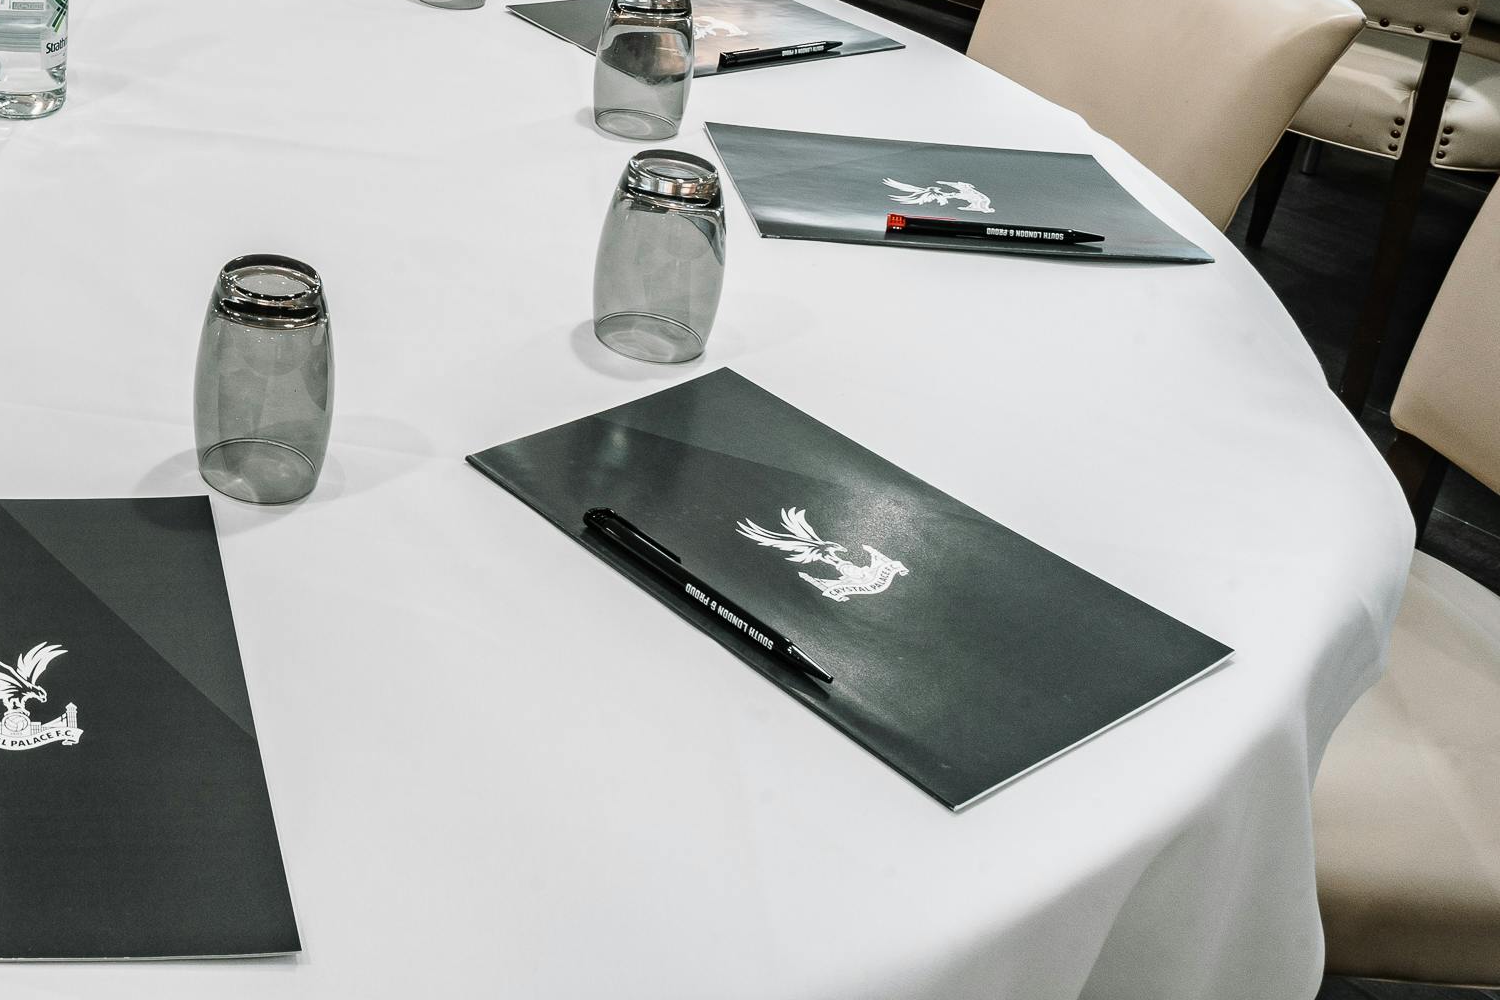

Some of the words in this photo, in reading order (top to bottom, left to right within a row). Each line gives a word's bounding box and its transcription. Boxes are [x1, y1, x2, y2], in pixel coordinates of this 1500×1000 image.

[986, 227, 1008, 236] PROUD
[1015, 229, 1042, 239] LONDON
[1043, 232, 1064, 241] SOUTH
[685, 583, 711, 606] PROUD
[829, 586, 871, 597] CRYSTAL
[717, 605, 749, 633] LONDON
[748, 626, 774, 650] SOUTH
[10, 732, 53, 748] PALACE
